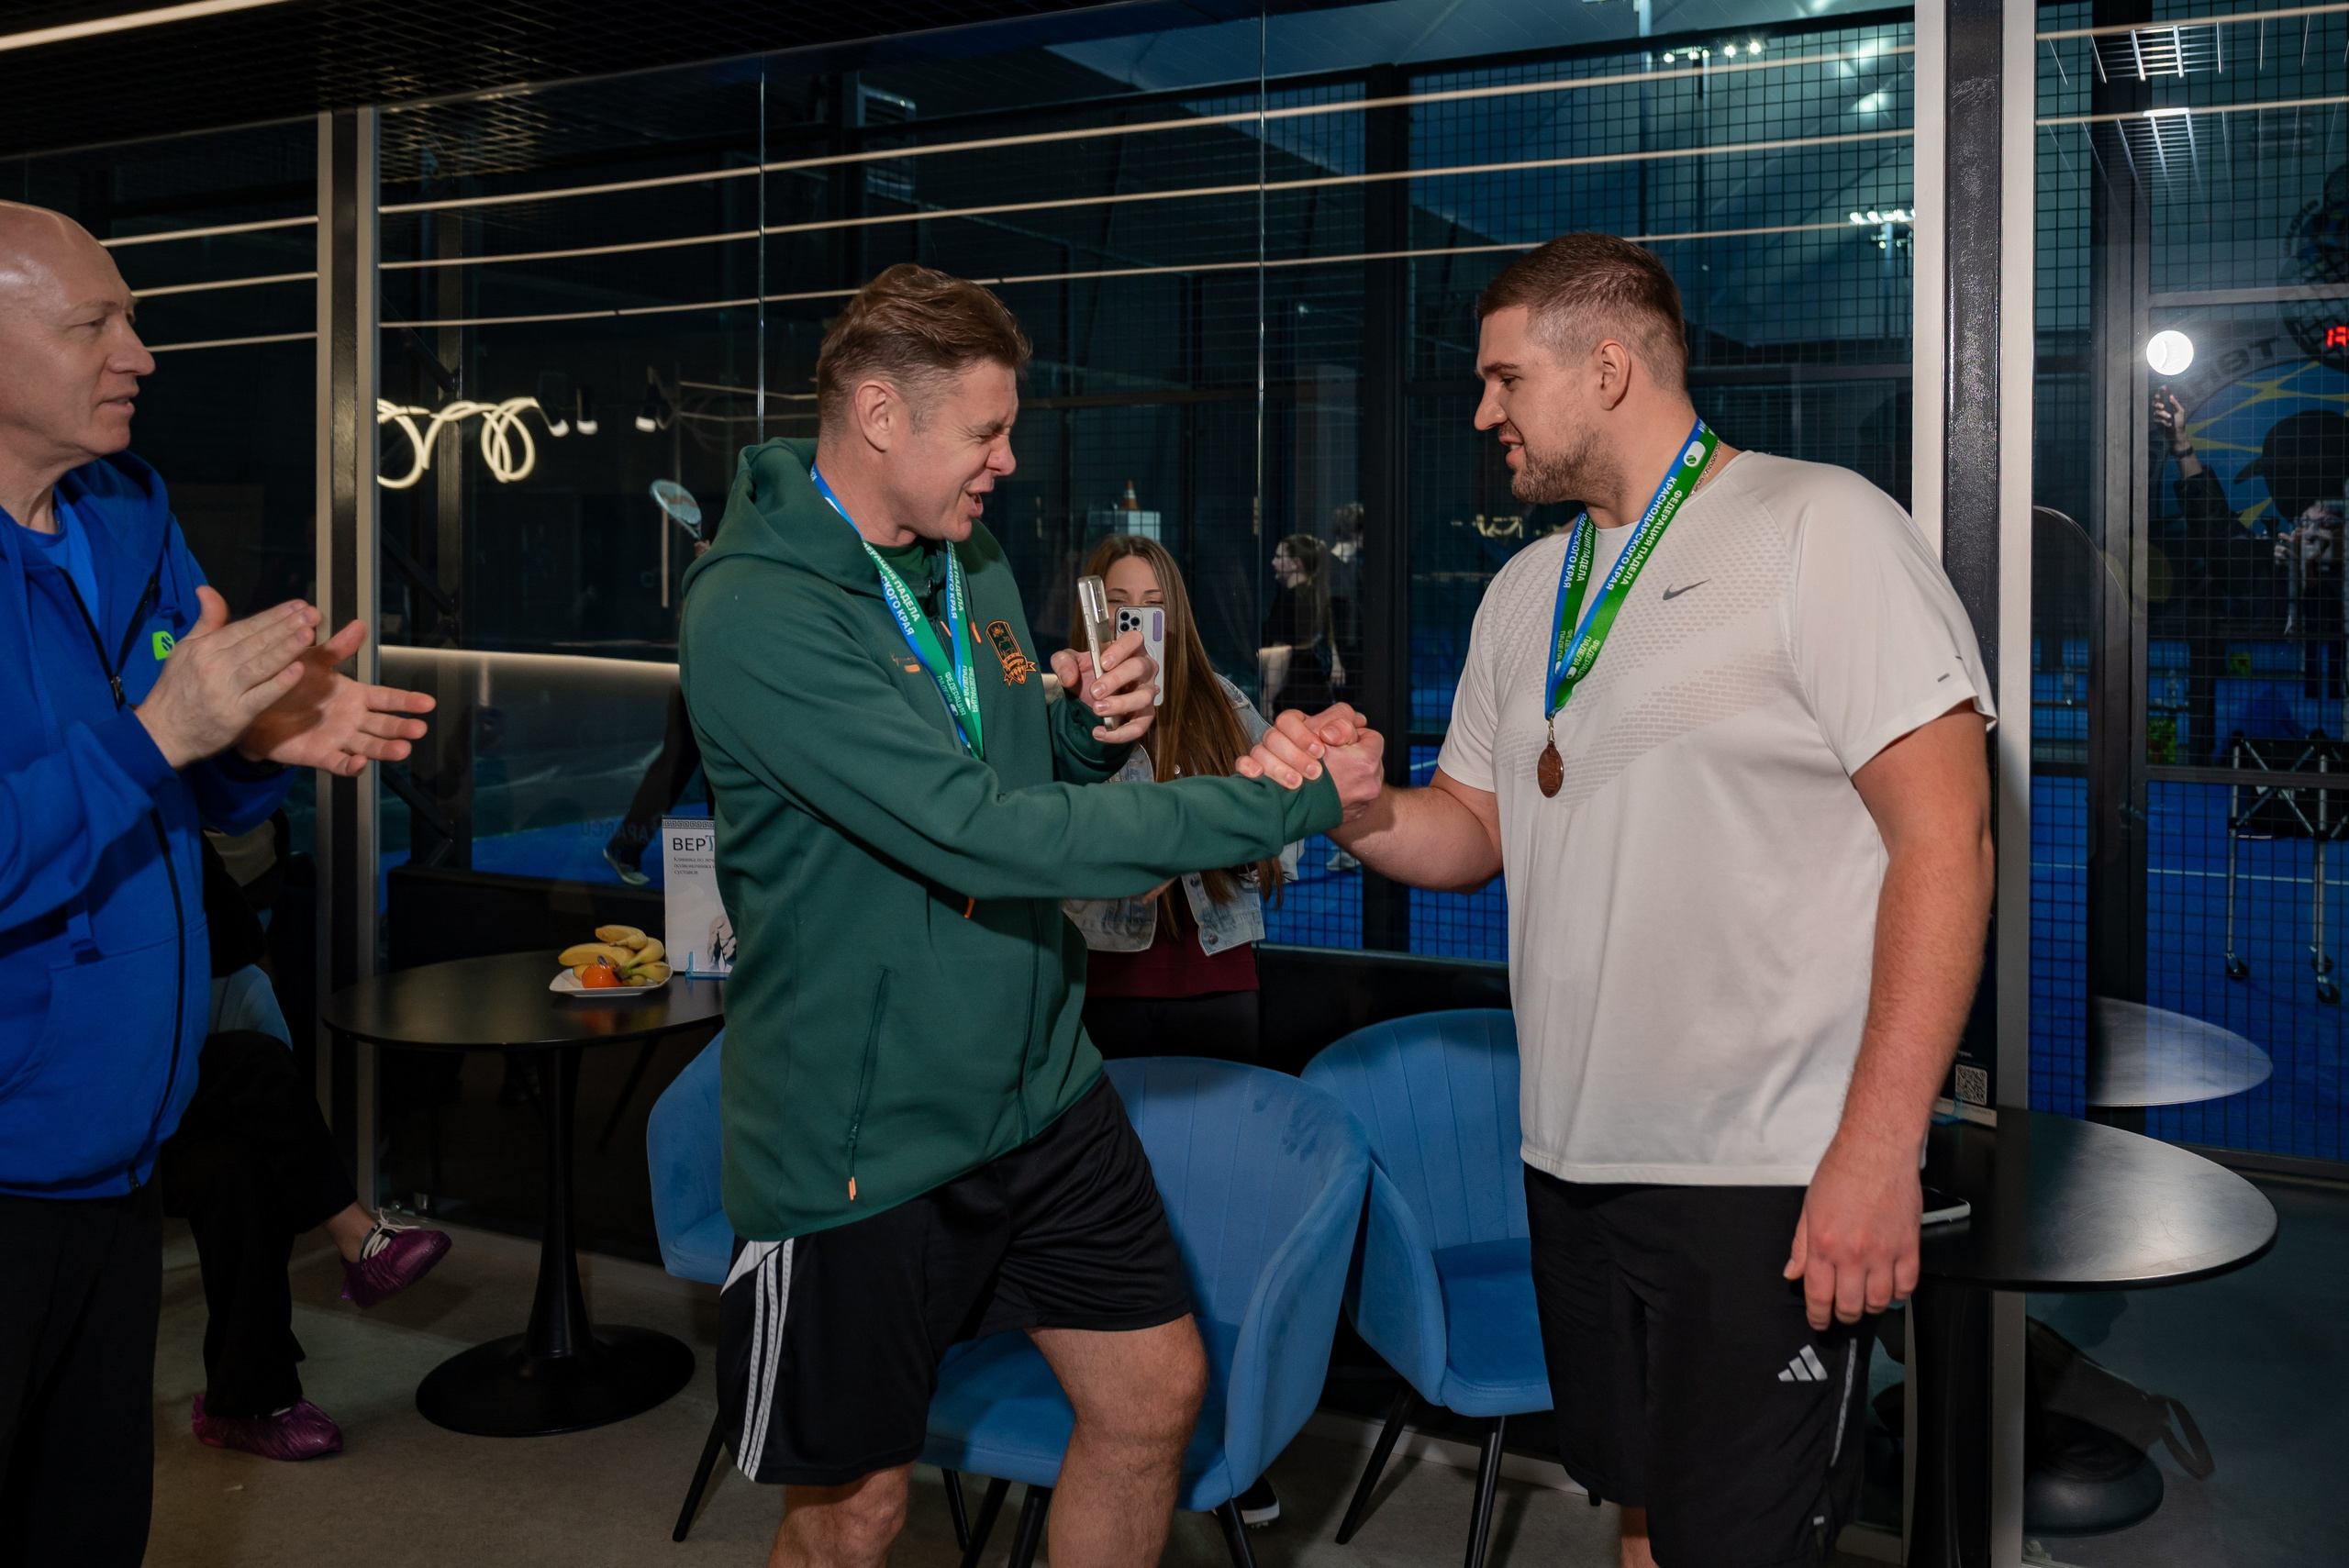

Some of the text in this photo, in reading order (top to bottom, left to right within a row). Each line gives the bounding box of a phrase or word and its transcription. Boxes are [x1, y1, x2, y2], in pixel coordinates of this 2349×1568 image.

[1563, 513, 1587, 588] ОДАРСКОГО КРАЯ
[1606, 476, 1677, 591] КРАСНОДАРСКОГО КРАЯ
[1620, 490, 1683, 584] ФЕДЕРАЦИЯ ПАДЕЛА
[1576, 547, 1591, 581] ПАДЕЛА
[894, 581, 920, 622] ПАДЕЛА
[896, 609, 915, 635] КРАЯ
[1572, 635, 1592, 666] ПАДЕЛА
[944, 671, 967, 716] ФЕДЕРАЦИЯ
